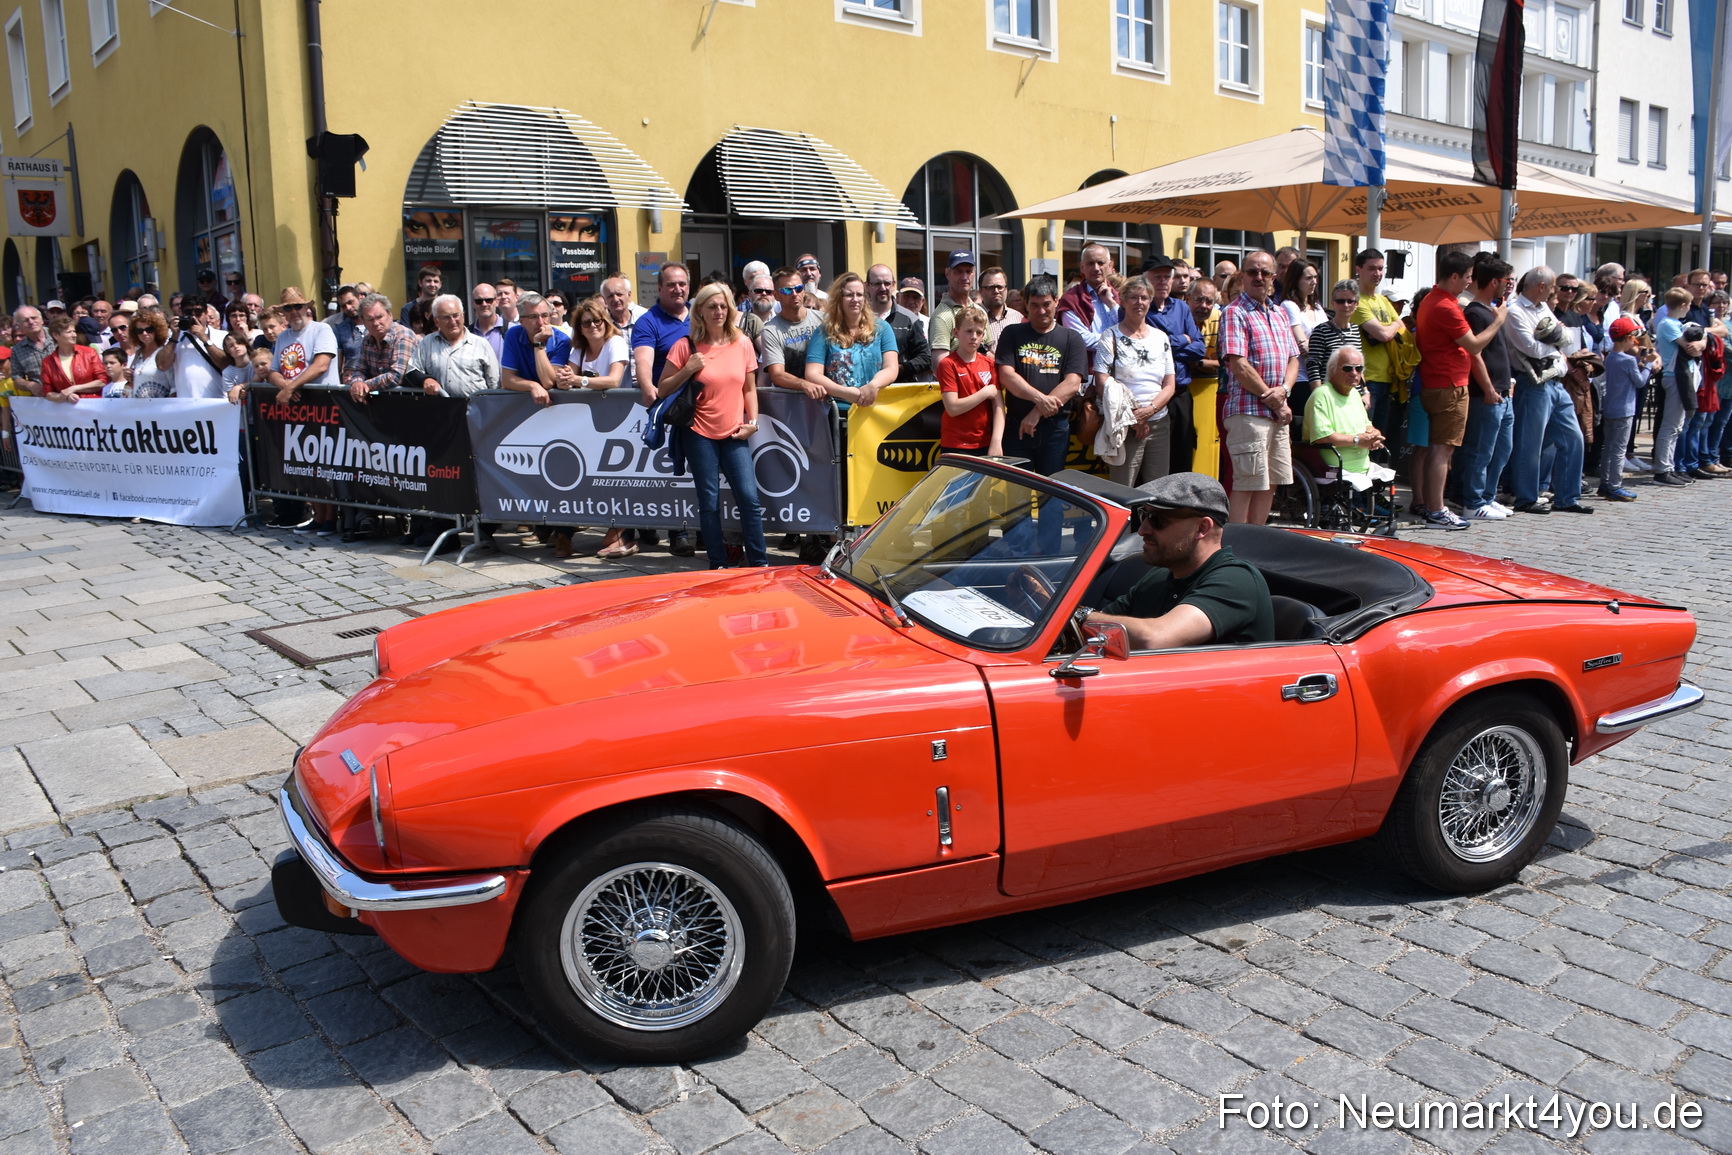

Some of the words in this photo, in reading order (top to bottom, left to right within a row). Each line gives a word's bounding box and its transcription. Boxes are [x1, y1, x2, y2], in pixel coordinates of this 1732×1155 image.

[8, 162, 51, 172] RATHAUS
[405, 245, 433, 255] Digitale
[434, 245, 456, 254] Bilder
[562, 247, 595, 256] Passbilder
[1340, 252, 1349, 263] 24
[551, 261, 607, 271] Bewerbungsbilder
[259, 402, 340, 425] FAHRSCHULE
[283, 423, 426, 477] Kohlmann
[427, 464, 461, 479] GmbH
[22, 455, 38, 467] DAS
[38, 458, 123, 475] NACHRICHTENPORTAL
[124, 462, 143, 475] FÜR
[283, 463, 314, 478] Neumarkt
[357, 470, 391, 487] Freystadt
[393, 476, 427, 492] Pyrbaum
[592, 478, 668, 488] BREITENBRUNN
[31, 486, 101, 500] www.neumarktaktuell.de
[974, 606, 1008, 621] 105
